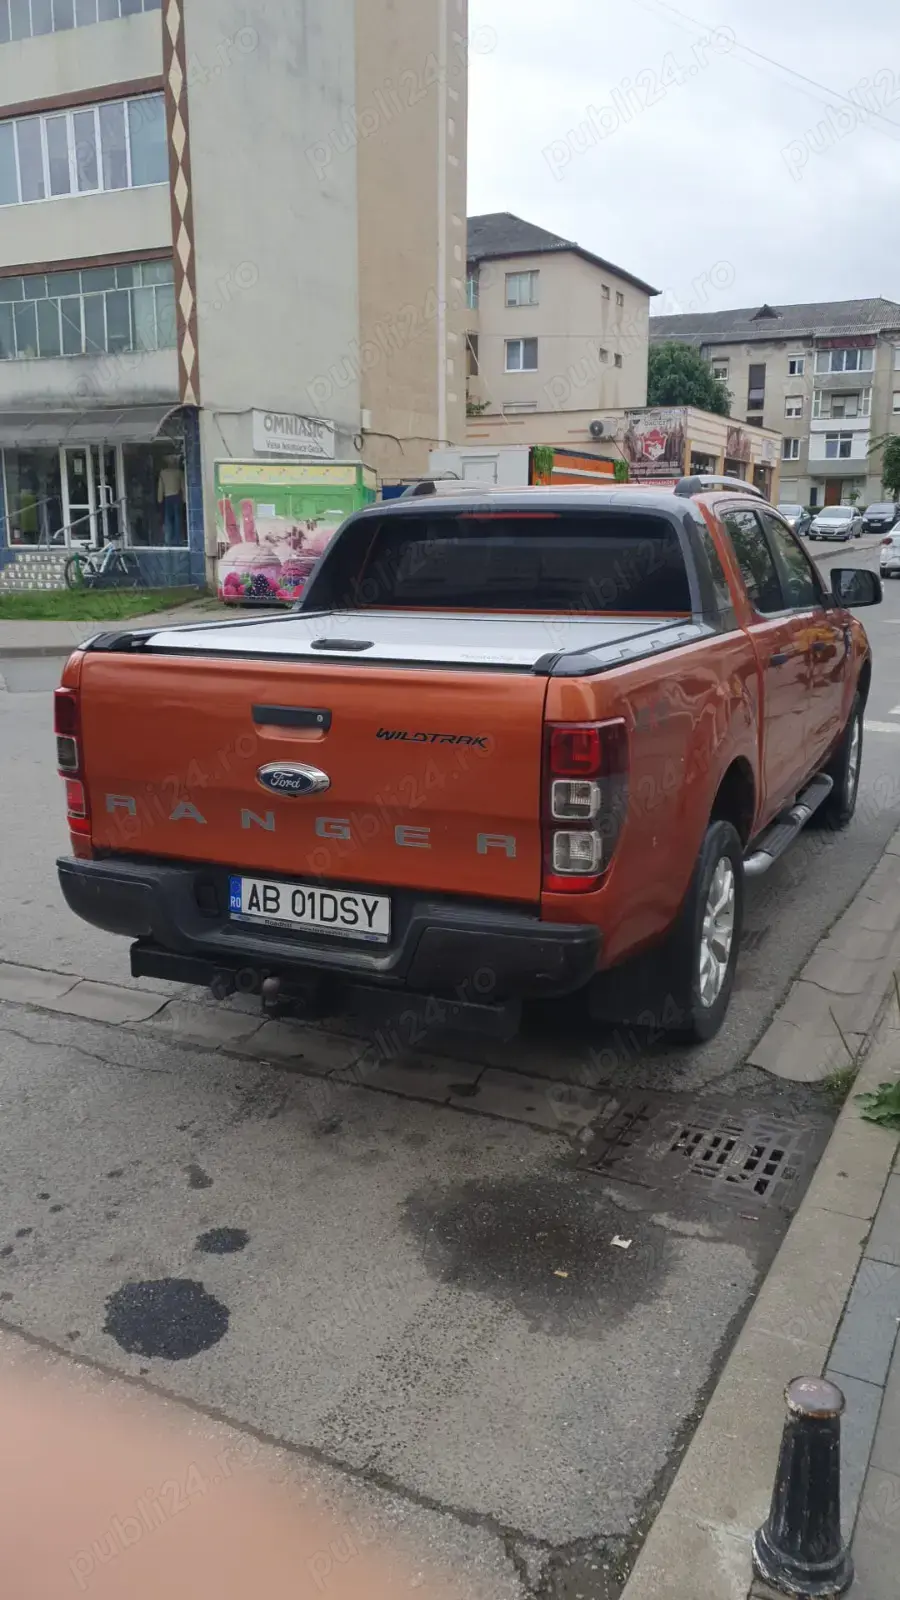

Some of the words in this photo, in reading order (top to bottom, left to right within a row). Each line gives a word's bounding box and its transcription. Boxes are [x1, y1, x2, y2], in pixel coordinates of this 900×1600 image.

[376, 727, 488, 748] WILDTRAK
[270, 771, 302, 789] Ford
[105, 793, 517, 858] RANGER
[248, 883, 281, 914] AB
[291, 889, 379, 928] 01DSY
